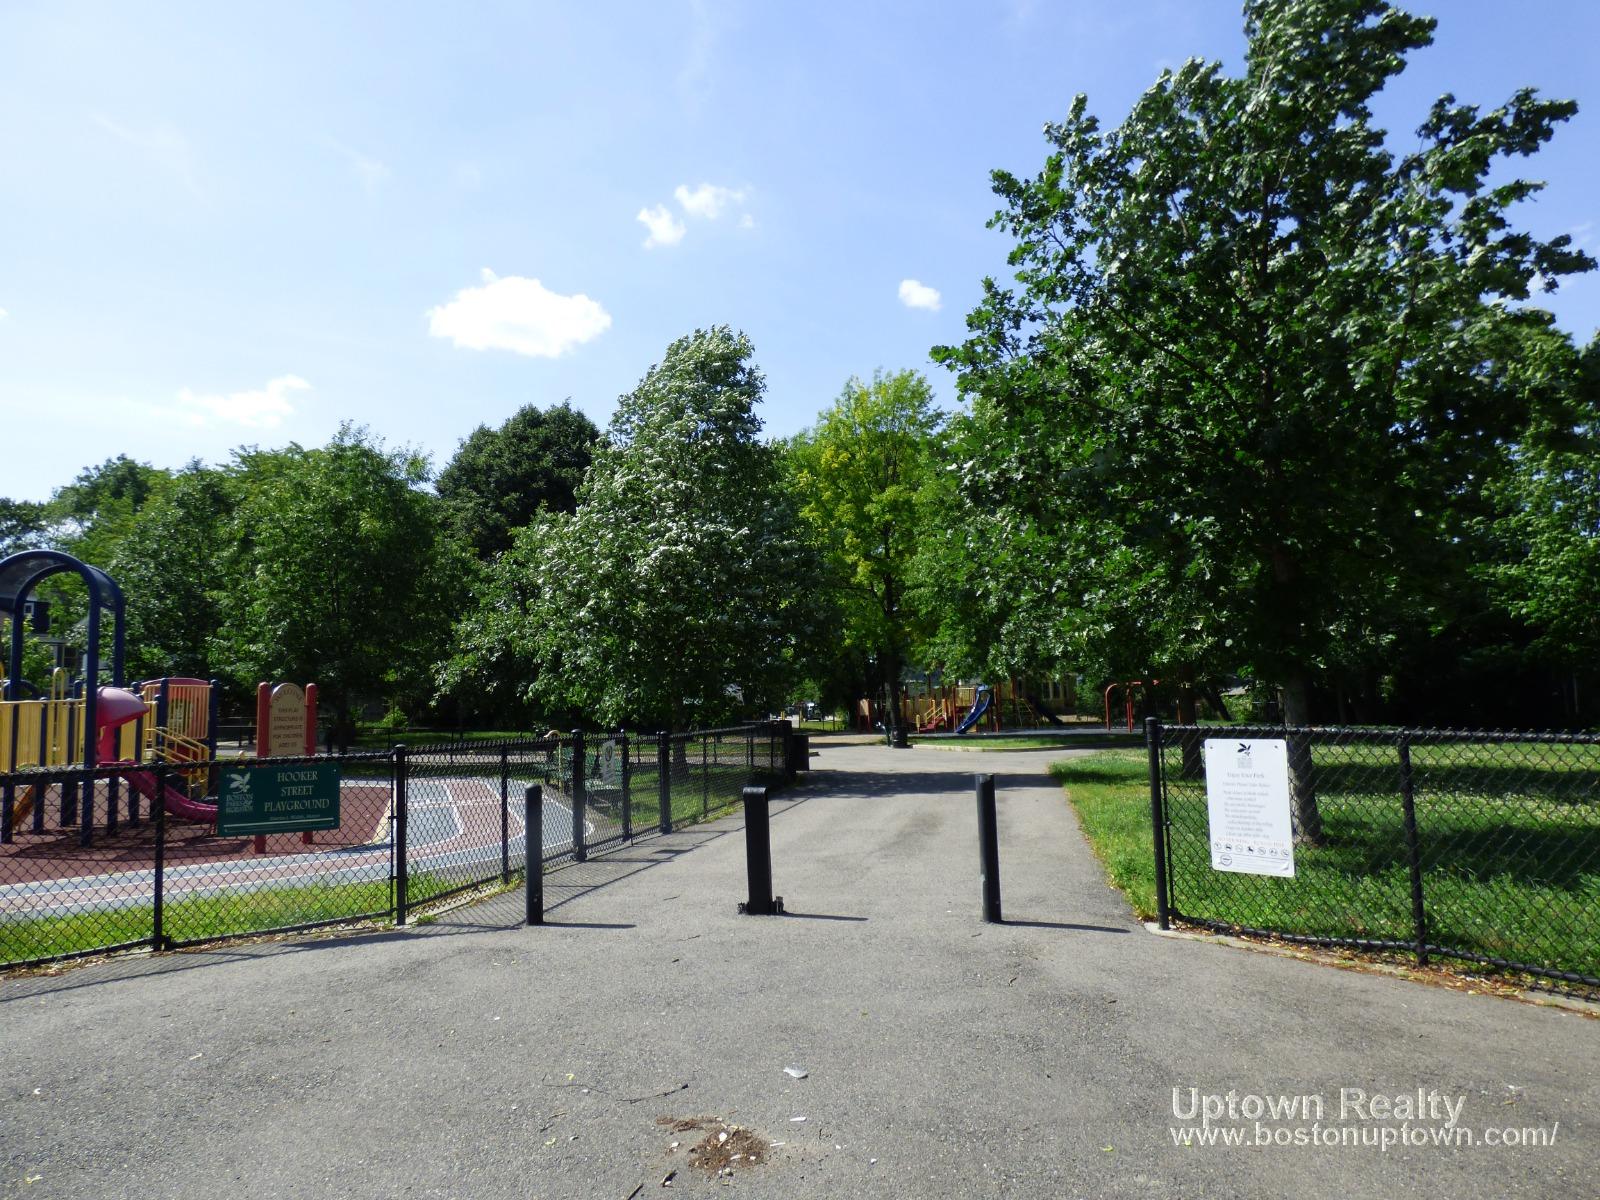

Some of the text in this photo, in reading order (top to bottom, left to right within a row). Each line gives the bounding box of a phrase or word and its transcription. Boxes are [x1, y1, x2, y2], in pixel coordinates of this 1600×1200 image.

[277, 770, 318, 783] HOOKER
[280, 785, 315, 797] STREET
[264, 798, 330, 812] PLAYGROUND
